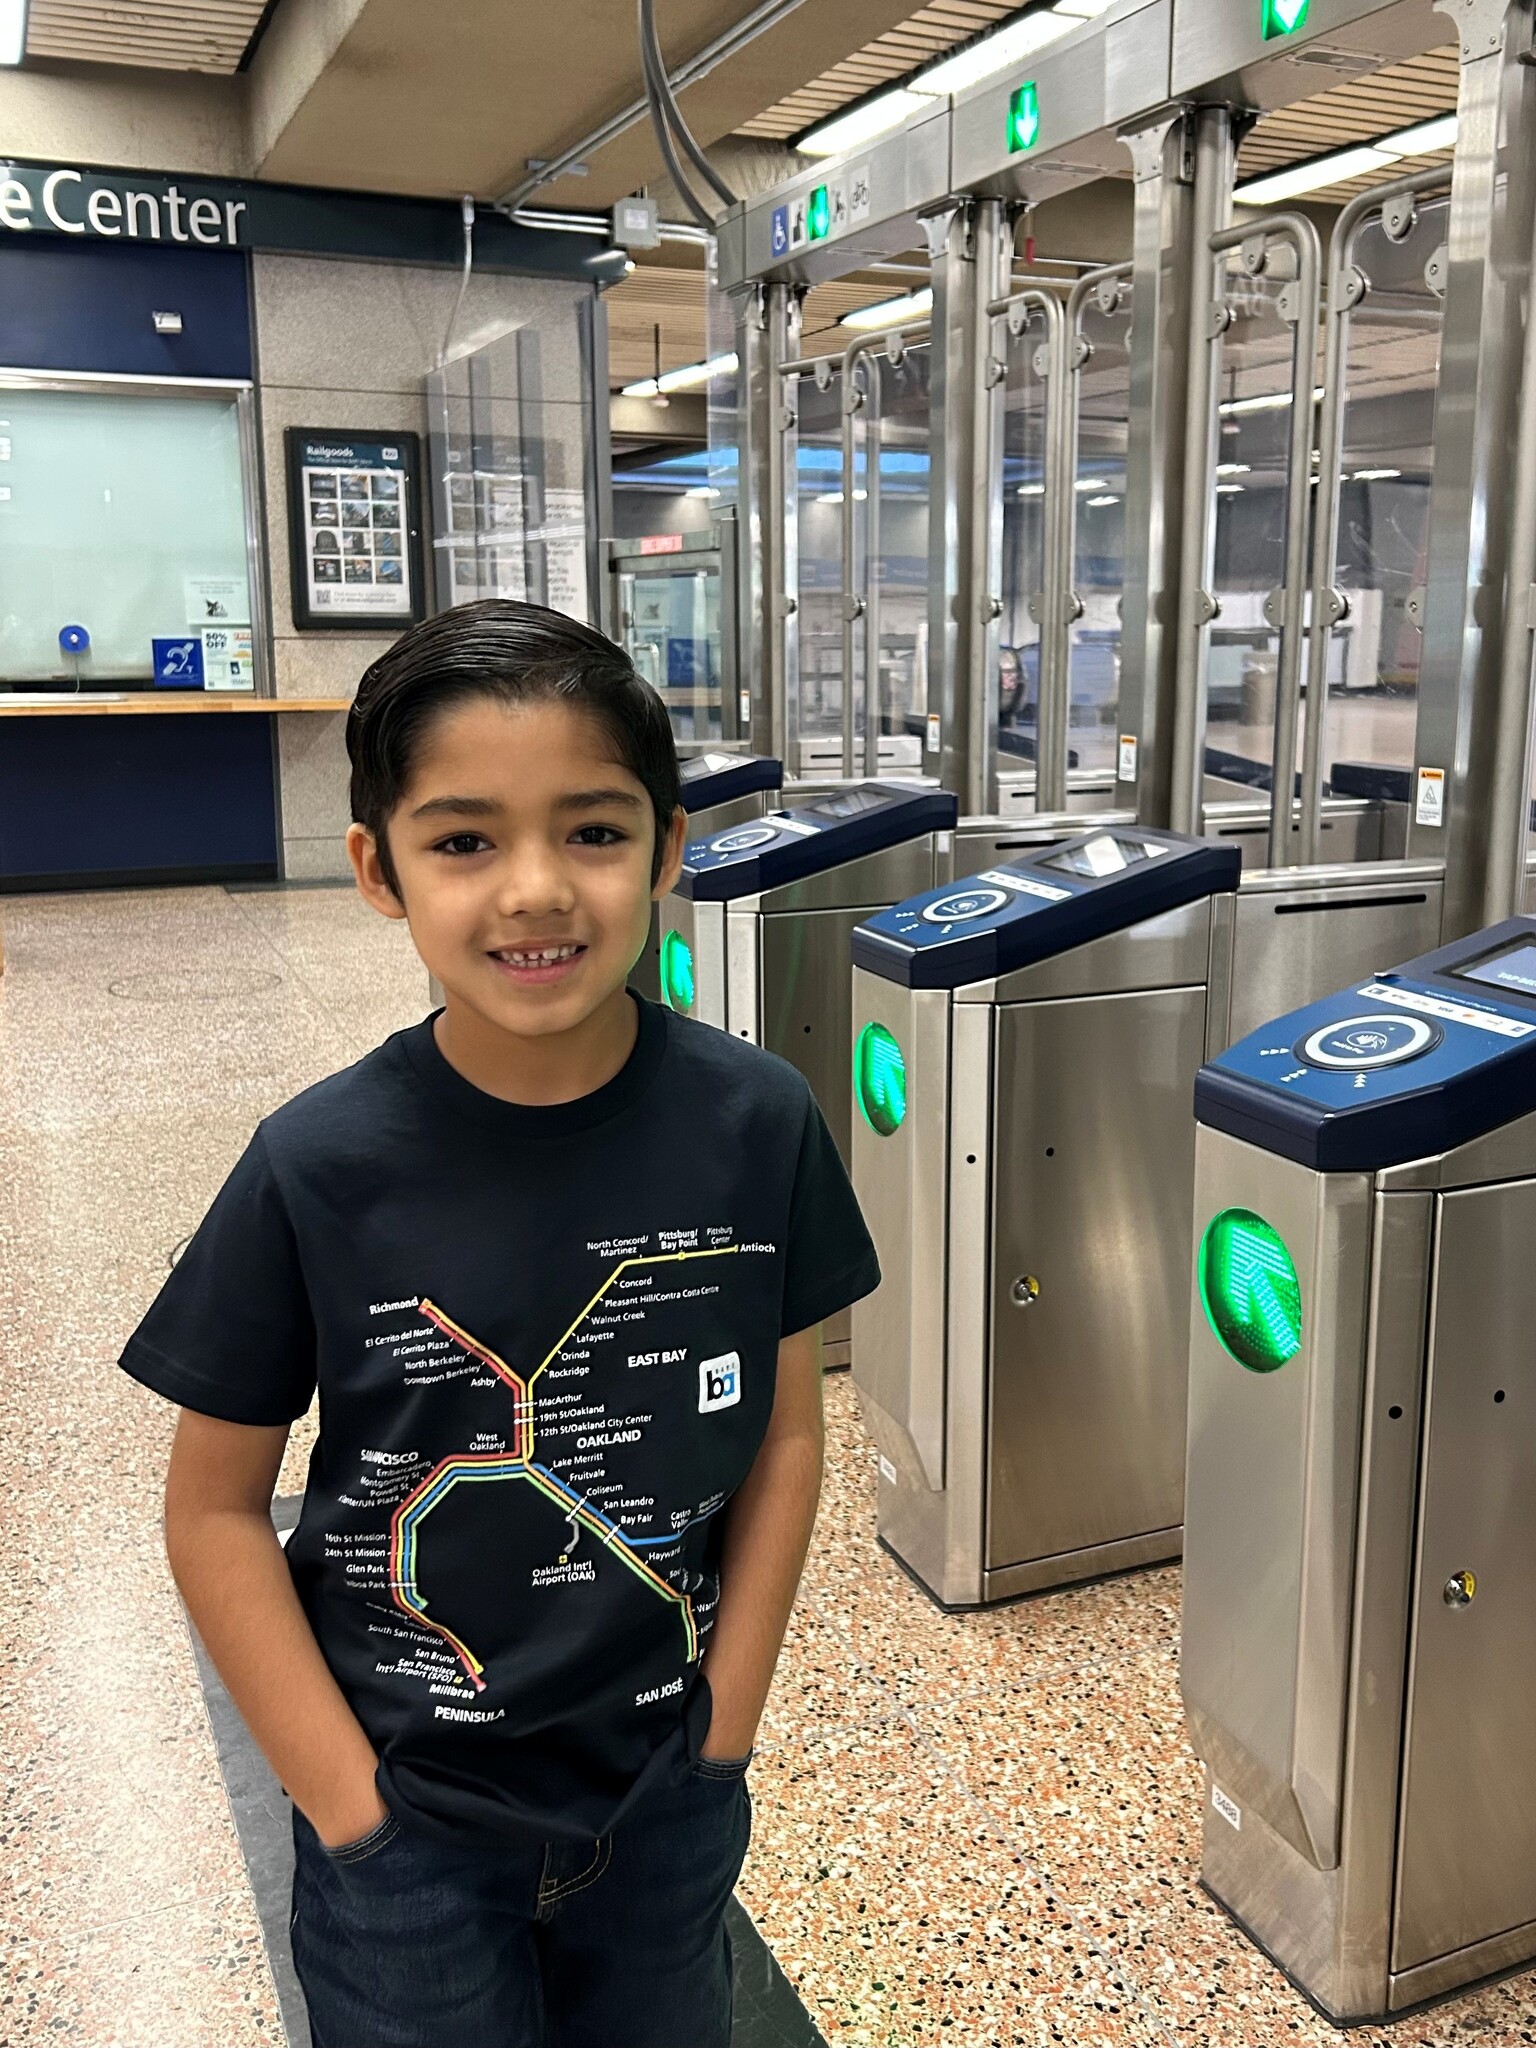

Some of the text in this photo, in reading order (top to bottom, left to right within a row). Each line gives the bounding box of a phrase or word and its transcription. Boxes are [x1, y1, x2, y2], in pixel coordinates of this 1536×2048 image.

[43, 169, 246, 245] Center
[206, 641, 226, 649] OFF
[659, 1228, 698, 1241] Pittsburg/
[587, 1235, 649, 1251] North Concord/
[661, 1238, 698, 1250] Bay Point
[740, 1242, 776, 1253] Antioch
[600, 1246, 637, 1257] Martinez
[619, 1277, 653, 1289] Concord
[369, 1296, 419, 1315] Richmond
[604, 1297, 638, 1308] Pleasant
[640, 1291, 681, 1303] Hill/Contra
[682, 1288, 700, 1298] Costa
[591, 1310, 646, 1325] Walnut Creek
[365, 1326, 434, 1348] El Cerrito del Norte
[576, 1330, 615, 1344] Lafayette
[400, 1344, 426, 1355] Cerrito
[428, 1340, 450, 1351] Plaza
[405, 1354, 466, 1370] North Berkeley
[561, 1350, 590, 1361] Orinda
[628, 1349, 688, 1368] EAST BAY
[446, 1363, 481, 1379] Berkeley
[549, 1366, 590, 1380] Rockridge
[471, 1377, 496, 1388] Ashby
[538, 1393, 582, 1407] MacArthur
[539, 1404, 605, 1423] 19th St/Oakland
[539, 1413, 653, 1438] 12th St/Oakland City Center
[476, 1433, 498, 1442] West
[576, 1429, 642, 1449] OAKLAND
[469, 1441, 506, 1451] Oakland
[553, 1452, 603, 1469] Lake Merritt
[376, 1461, 432, 1477] Embarcadero
[569, 1468, 605, 1483] Fruitvale
[370, 1483, 409, 1498] Powell St
[586, 1483, 623, 1497] Coliseum
[377, 1495, 400, 1506] Plaza
[604, 1496, 654, 1510] San Leandro
[621, 1513, 653, 1527] Bay Fair
[325, 1532, 386, 1543] 16th St Mission
[325, 1548, 386, 1558] 24th St Mission
[648, 1546, 681, 1563] Hayward
[346, 1564, 385, 1574] Glen Park
[532, 1563, 570, 1578] Oakland
[369, 1580, 386, 1589] Park
[532, 1570, 596, 1587] Airport (OAK)
[368, 1623, 392, 1637] South
[394, 1628, 409, 1639] San
[410, 1632, 444, 1646] Francisco
[415, 1647, 455, 1664] San Bruno
[394, 1665, 427, 1680] Airport
[398, 1658, 456, 1676] San Francisco
[429, 1682, 475, 1700] Millbrae
[635, 1688, 659, 1707] SAN
[434, 1705, 506, 1724] PENINSULA
